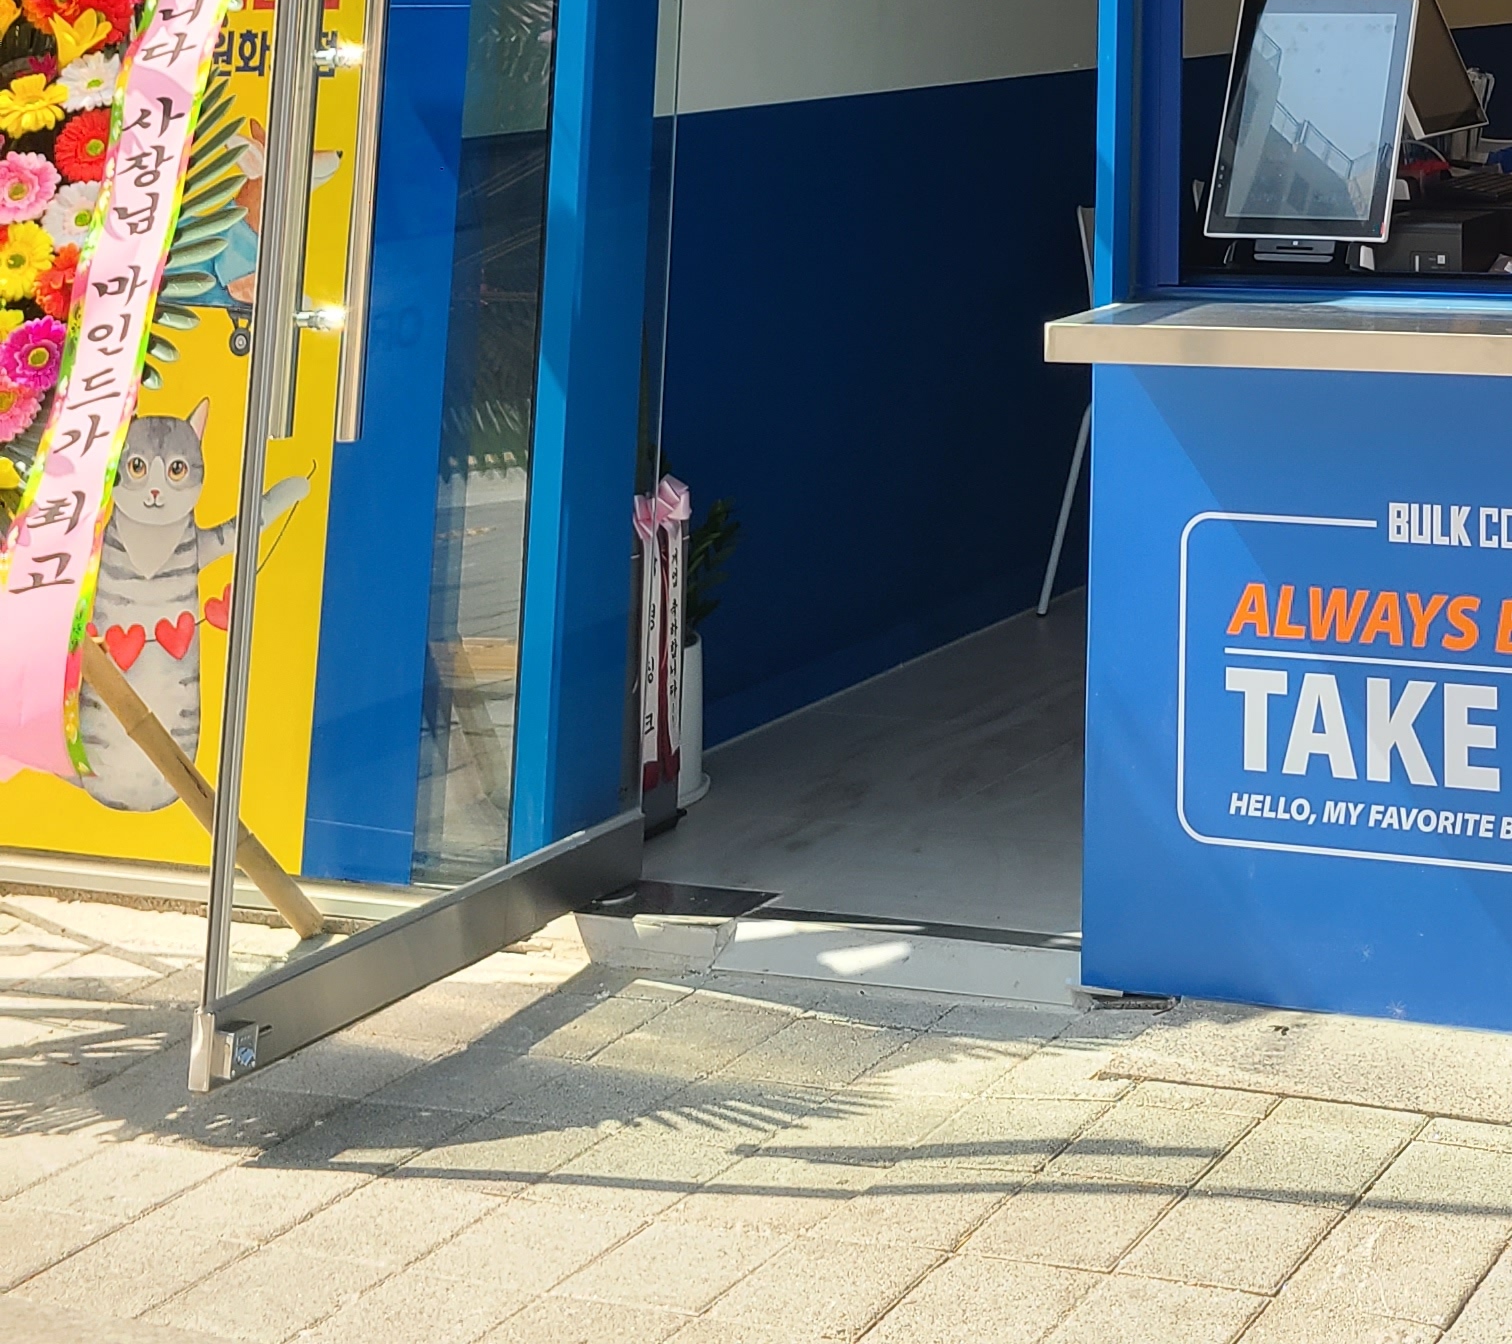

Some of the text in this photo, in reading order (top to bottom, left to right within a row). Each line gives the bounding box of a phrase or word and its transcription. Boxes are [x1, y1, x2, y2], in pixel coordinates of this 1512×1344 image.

[112, 96, 185, 237] 사장님
[53, 264, 148, 458] 마인드가
[9, 490, 86, 595] 최고
[1389, 501, 1471, 547] BULK
[1226, 582, 1482, 652] ALWAYS
[1225, 666, 1500, 792] TAKE
[1229, 792, 1317, 826] HELLO,
[1323, 801, 1363, 826] MY
[1367, 804, 1495, 840] FAVORITE
